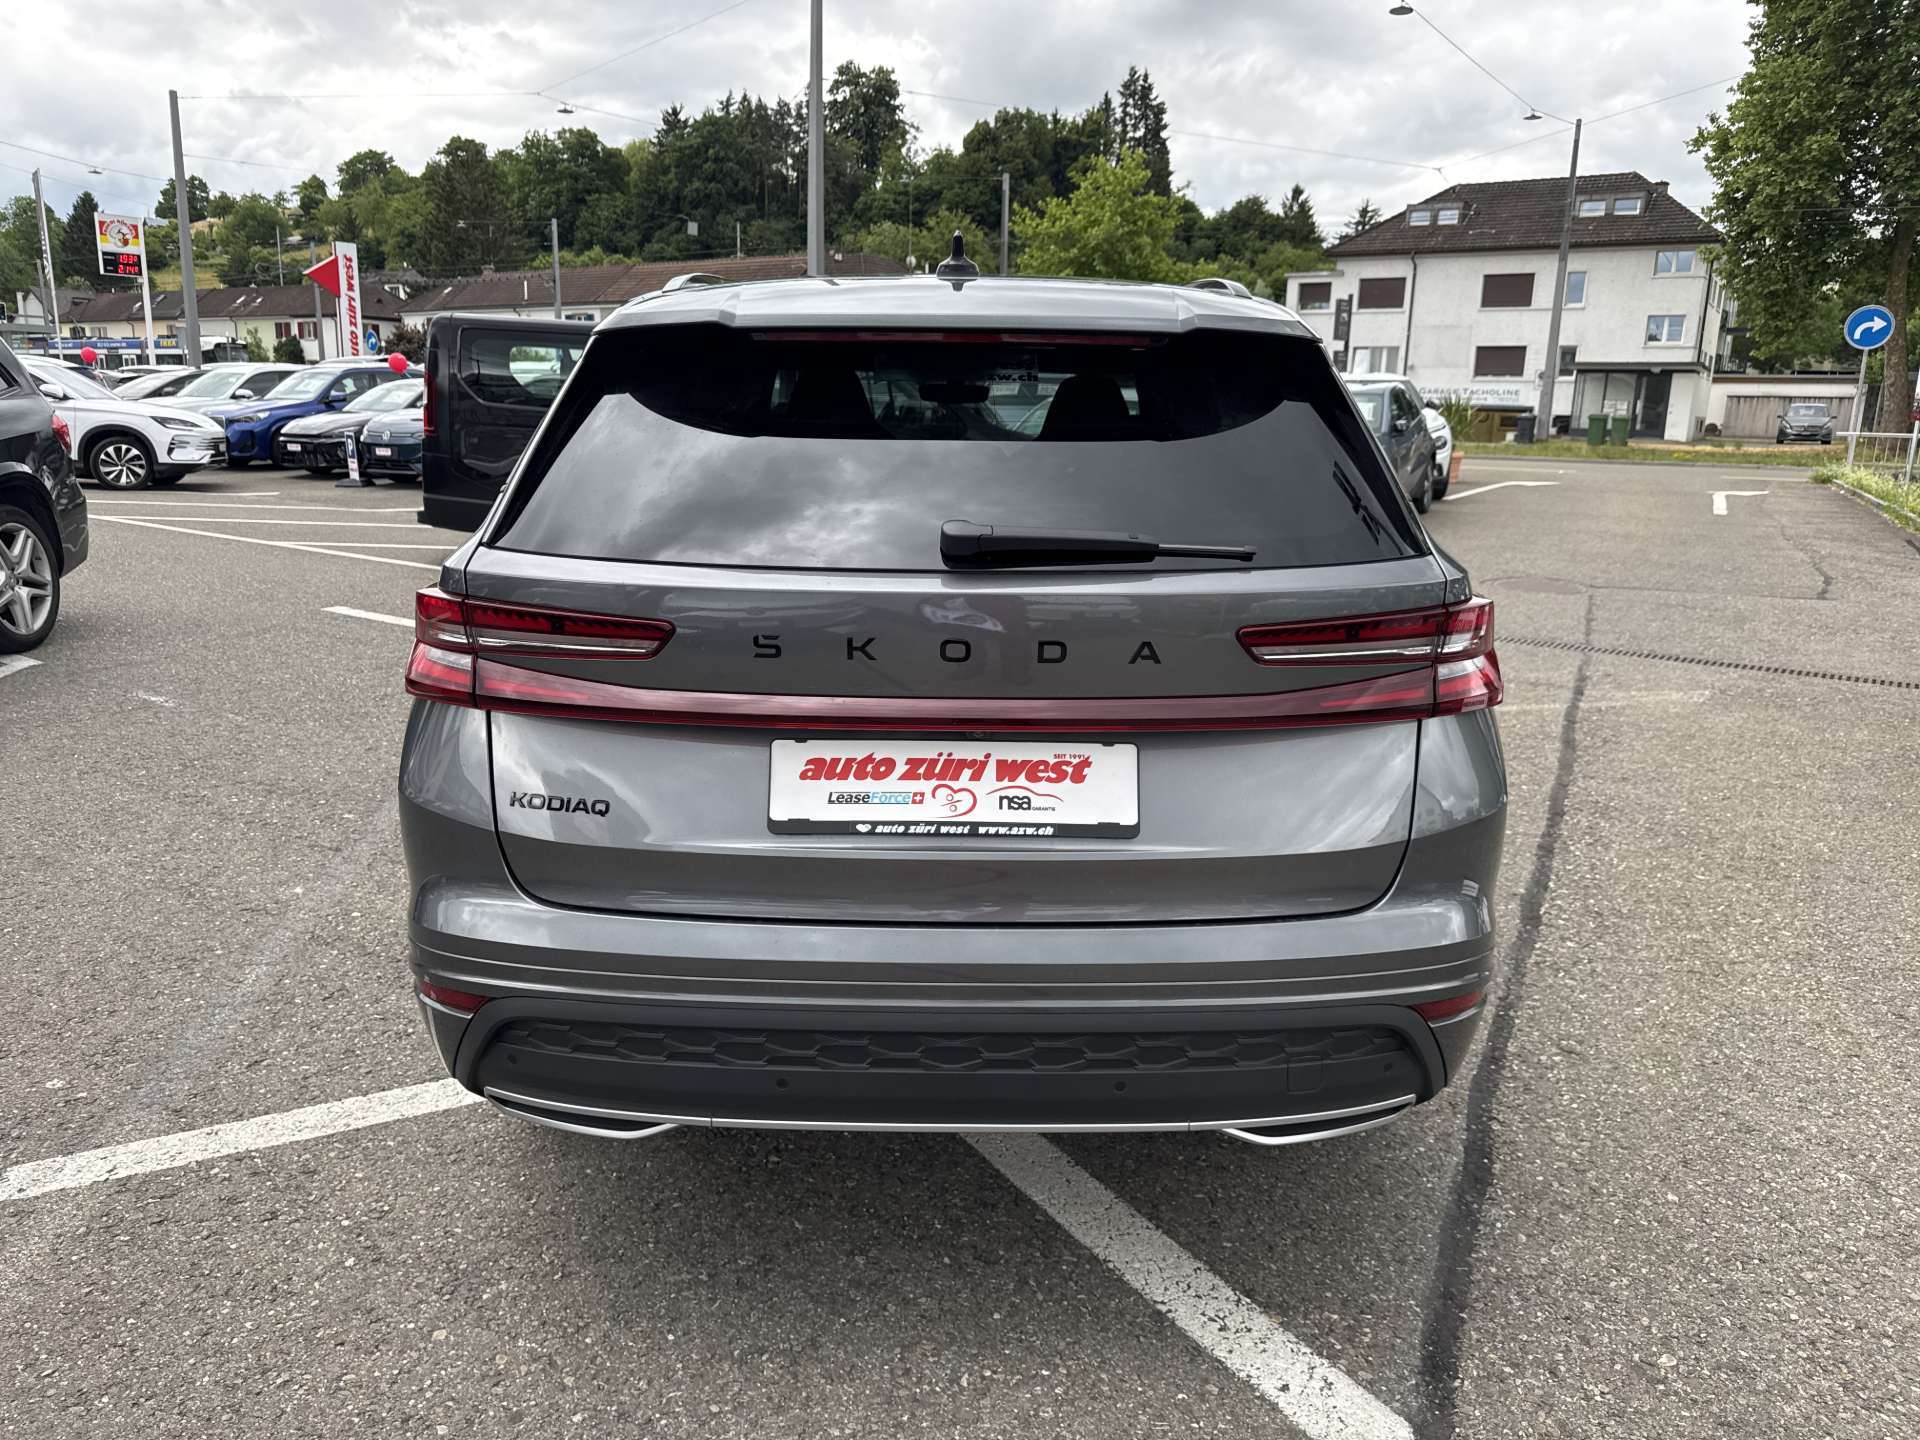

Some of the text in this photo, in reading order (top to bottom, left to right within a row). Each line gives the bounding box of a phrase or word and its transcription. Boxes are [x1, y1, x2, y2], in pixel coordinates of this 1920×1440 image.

[343, 254, 355, 292] west
[348, 330, 359, 357] uto
[1462, 387, 1521, 397] TACHOLINE
[798, 751, 1093, 785] auto züri west
[509, 791, 611, 818] KODIAQ
[827, 791, 912, 804] LeaseForce
[998, 794, 1032, 811] nsa
[874, 824, 906, 834] auto
[907, 822, 937, 834] züri
[939, 824, 970, 835] west
